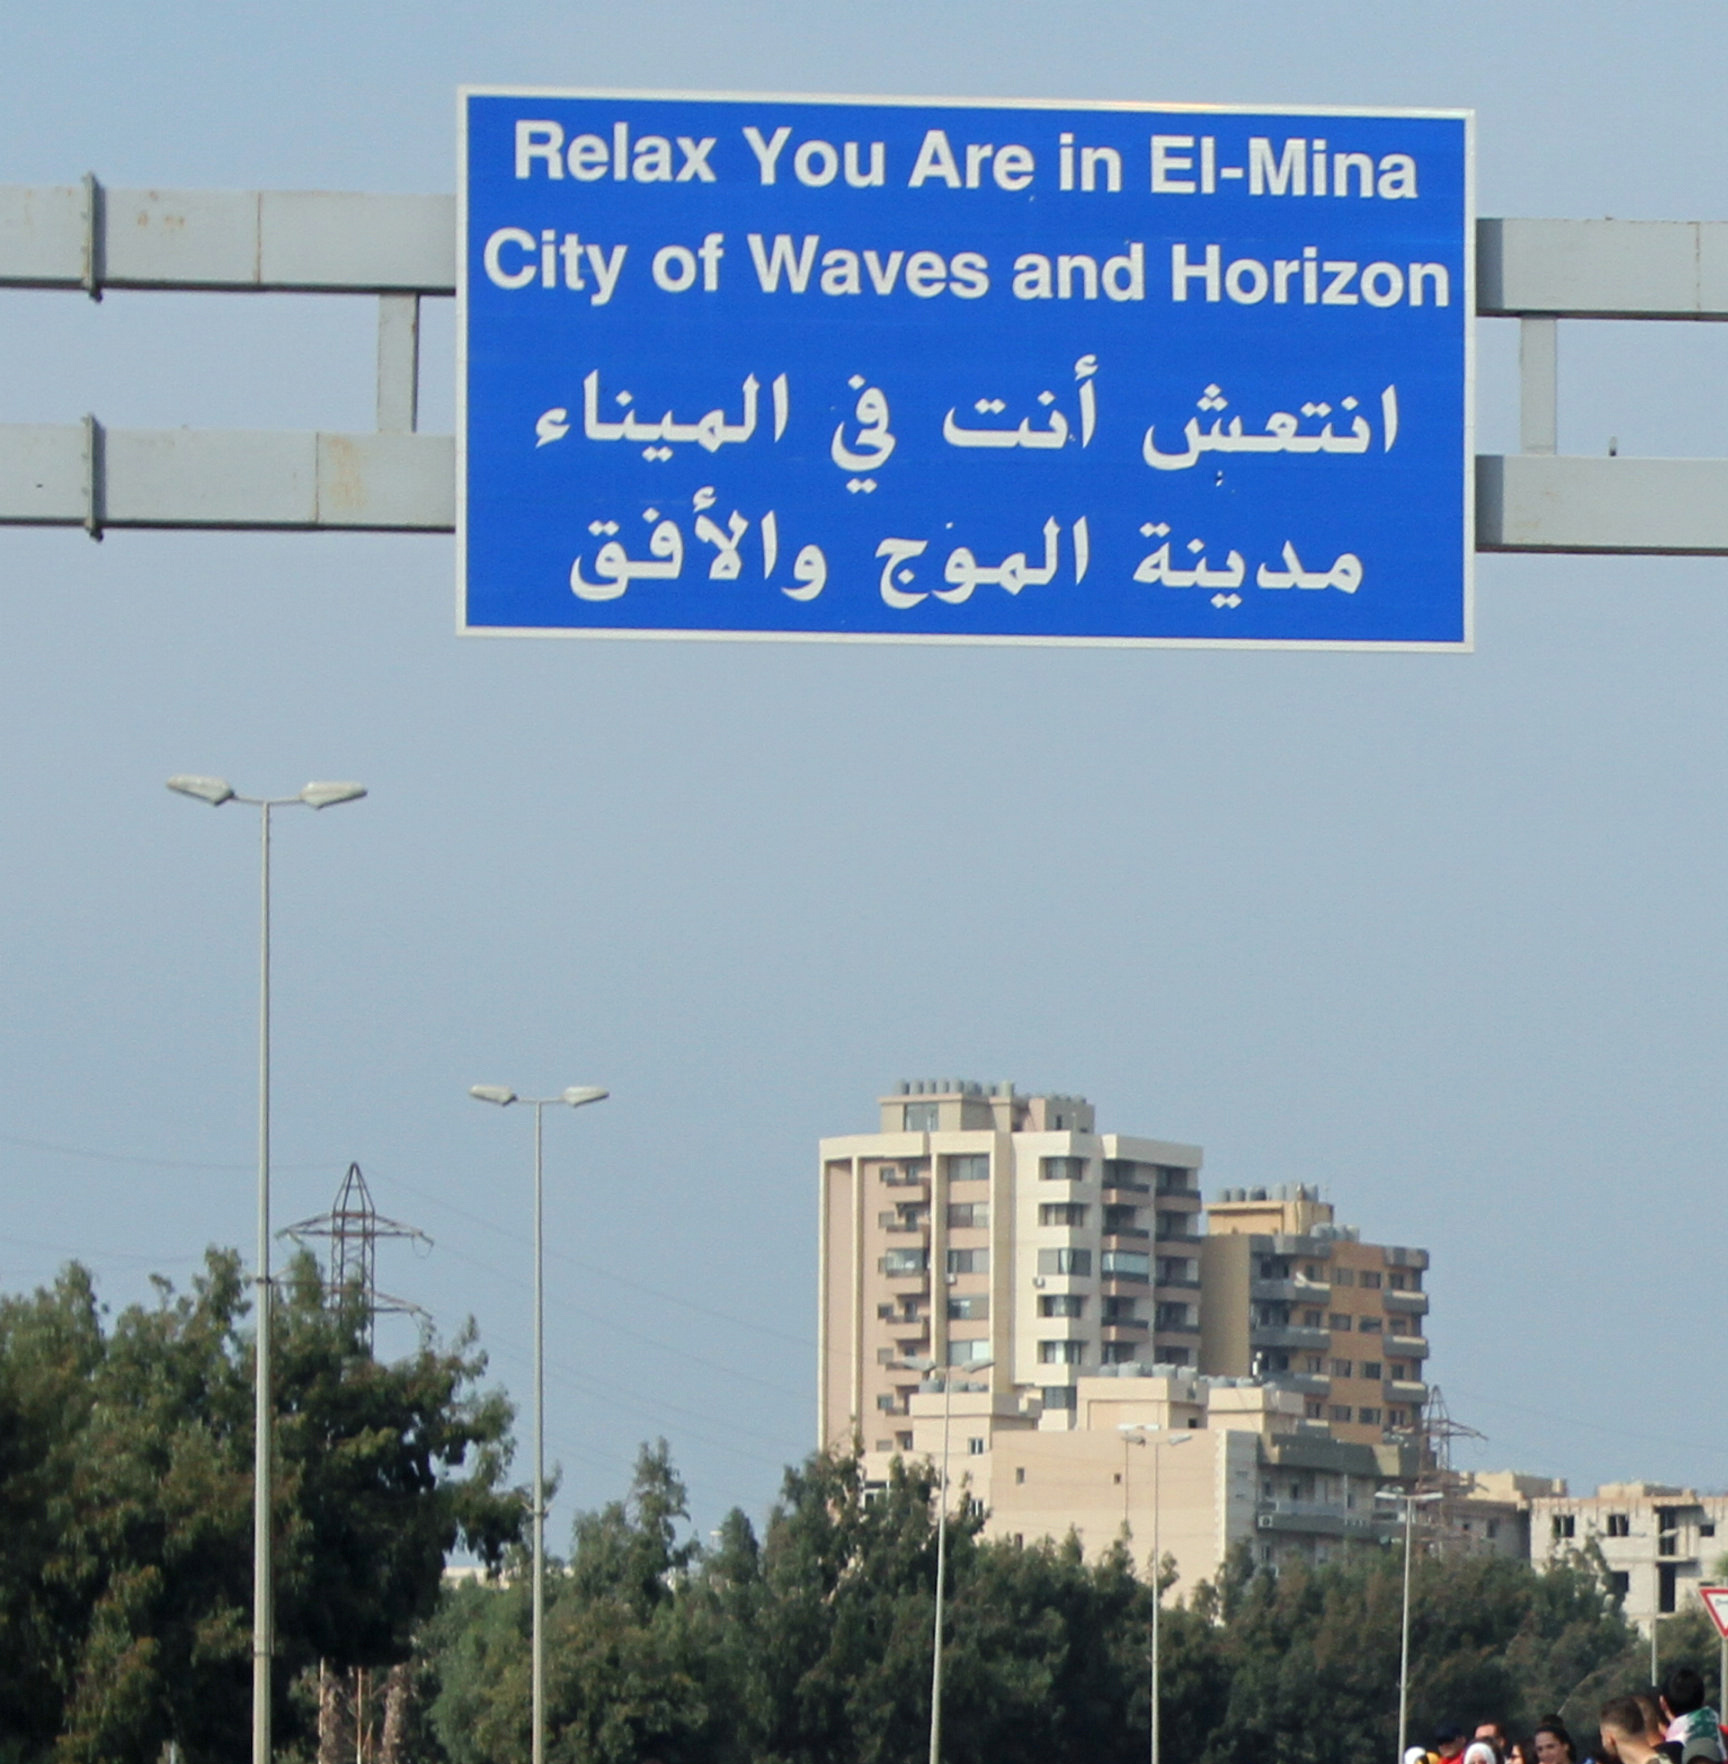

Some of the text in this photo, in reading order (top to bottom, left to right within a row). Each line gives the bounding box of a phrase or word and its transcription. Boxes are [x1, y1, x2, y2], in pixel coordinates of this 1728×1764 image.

[515, 119, 1419, 200] Relax You Are in El-Mina
[483, 227, 1449, 308] City of Waves and Horizon
[535, 354, 1398, 494] انتعش أنت في الميناء
[569, 486, 1363, 609] مدينة الموج والأفق
